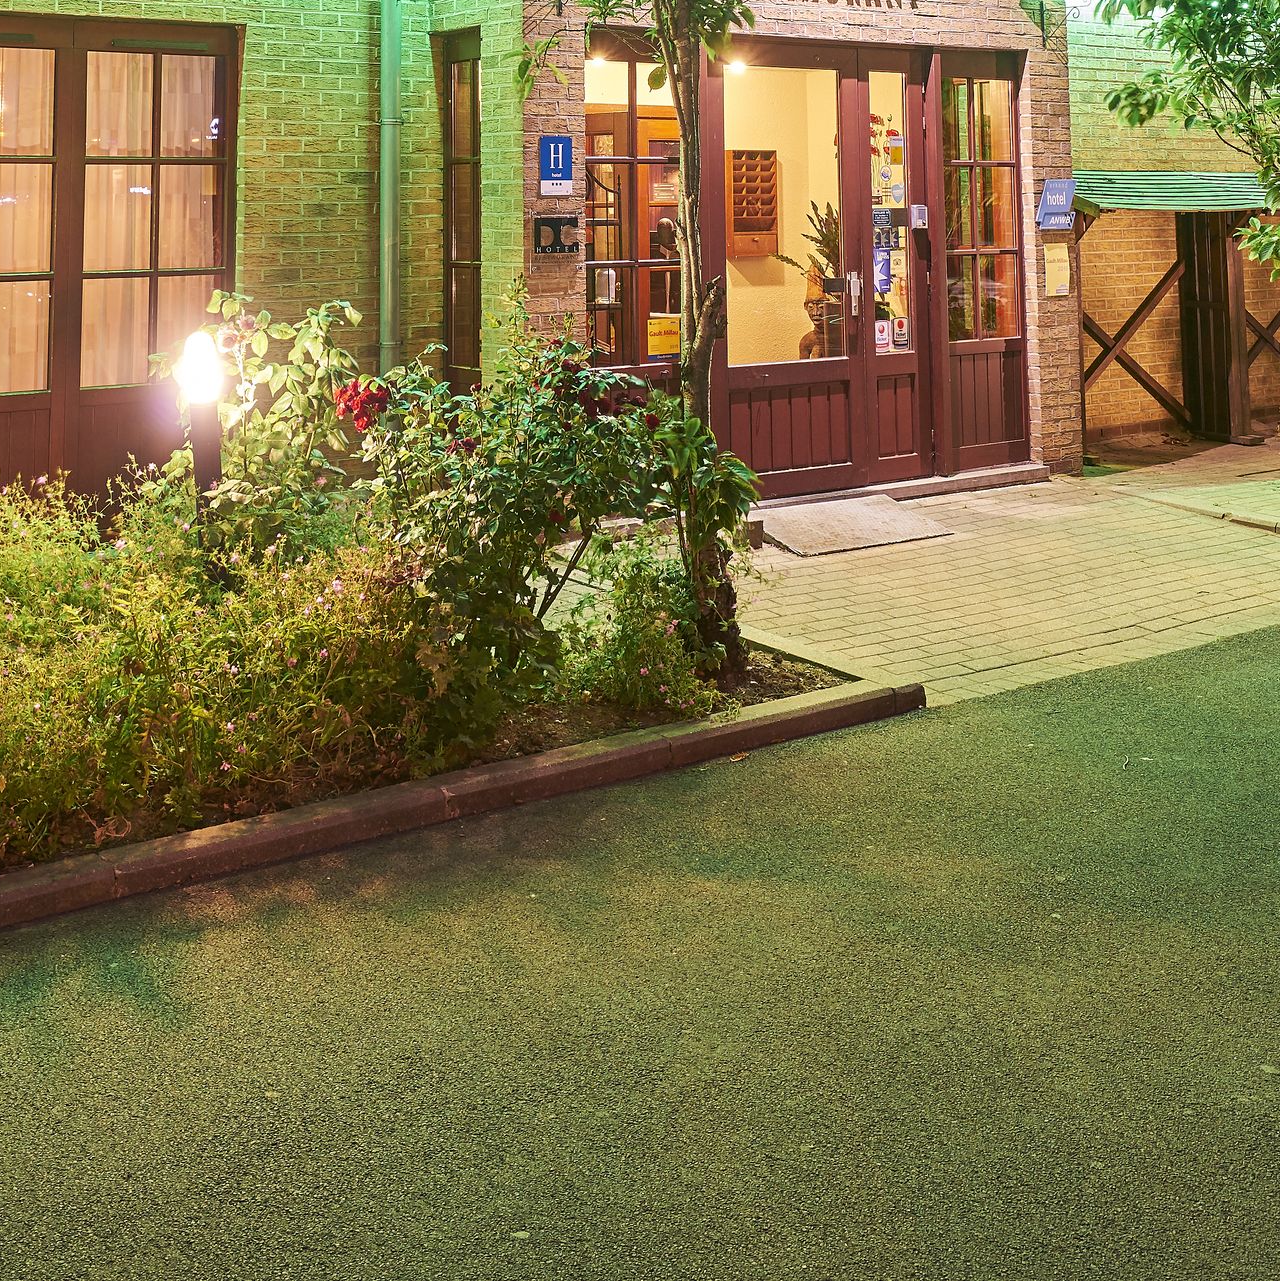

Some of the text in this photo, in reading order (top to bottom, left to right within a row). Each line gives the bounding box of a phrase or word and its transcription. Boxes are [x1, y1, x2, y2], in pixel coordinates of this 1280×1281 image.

[549, 143, 564, 169] H
[1046, 191, 1066, 206] hotel
[1049, 216, 1071, 225] ANWB
[534, 218, 579, 248] DC
